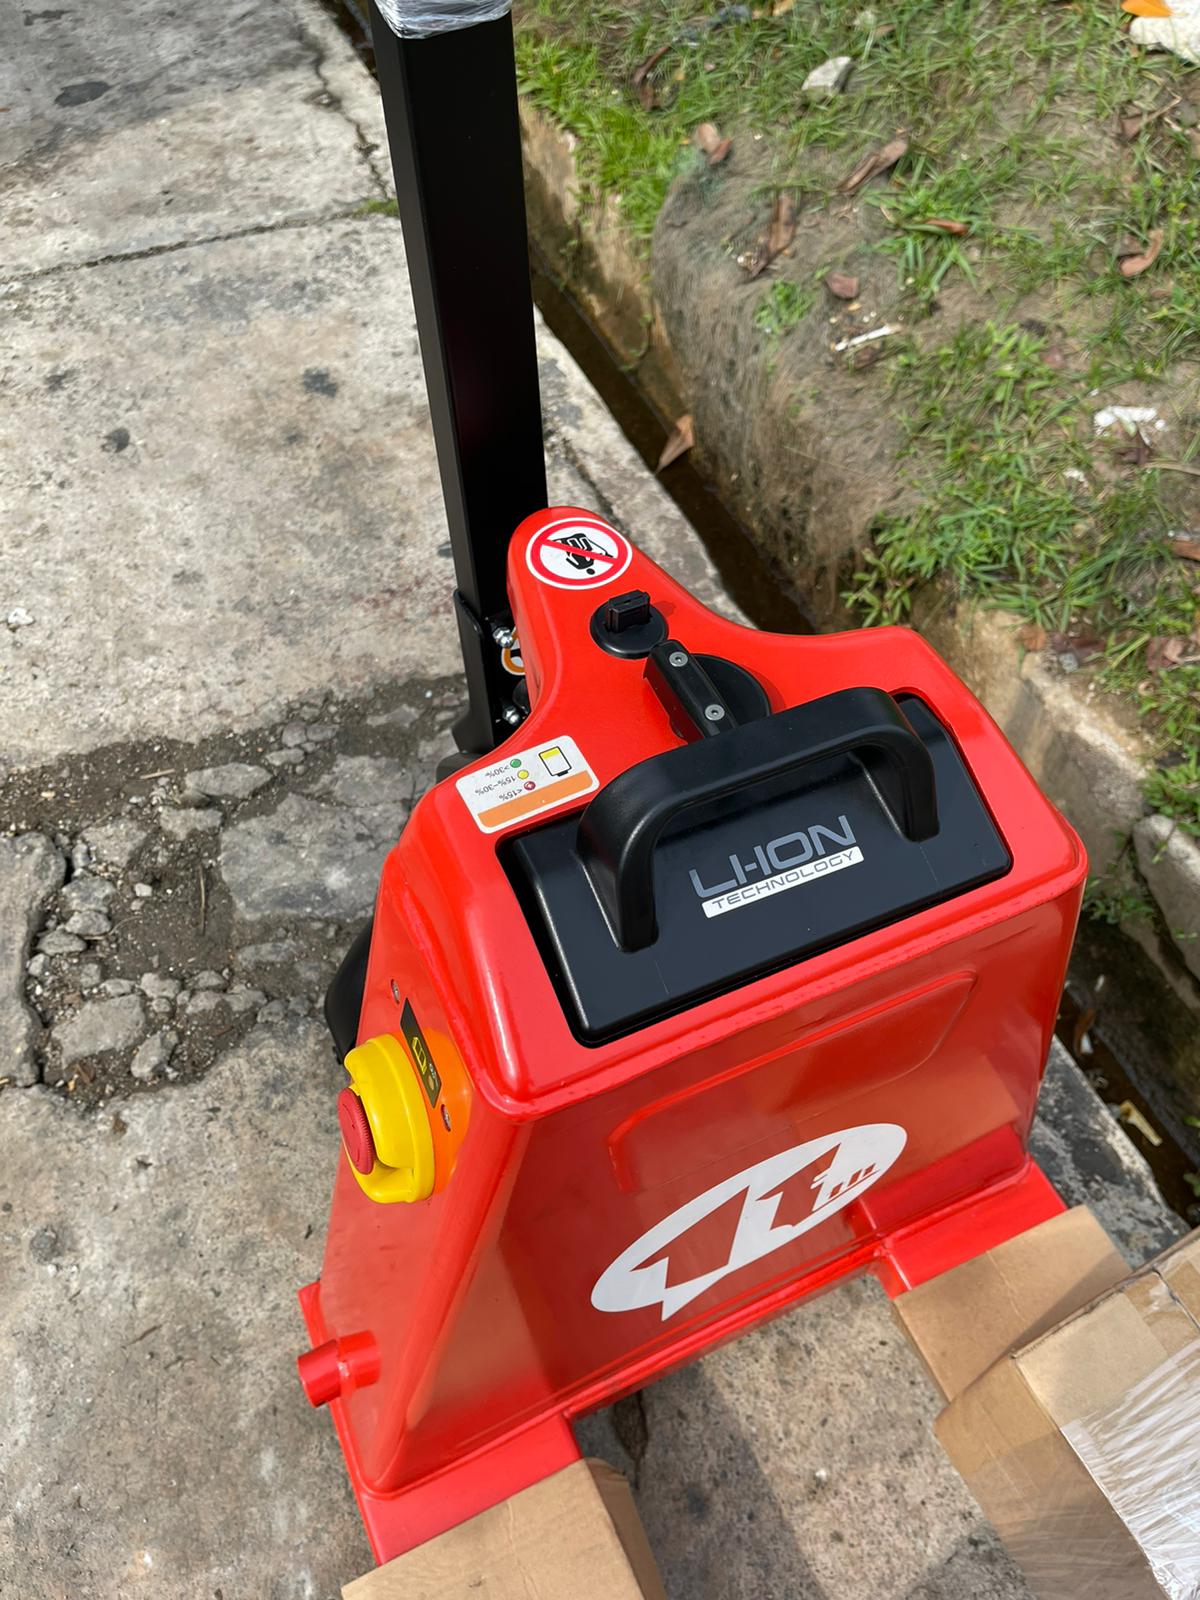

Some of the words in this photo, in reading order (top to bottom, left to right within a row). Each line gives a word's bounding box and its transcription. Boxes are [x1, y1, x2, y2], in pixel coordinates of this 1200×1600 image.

[485, 765, 510, 778] >30%
[498, 788, 523, 801] <15%
[688, 815, 857, 898] LI-ION
[711, 850, 854, 909] TECHNOLOGY
